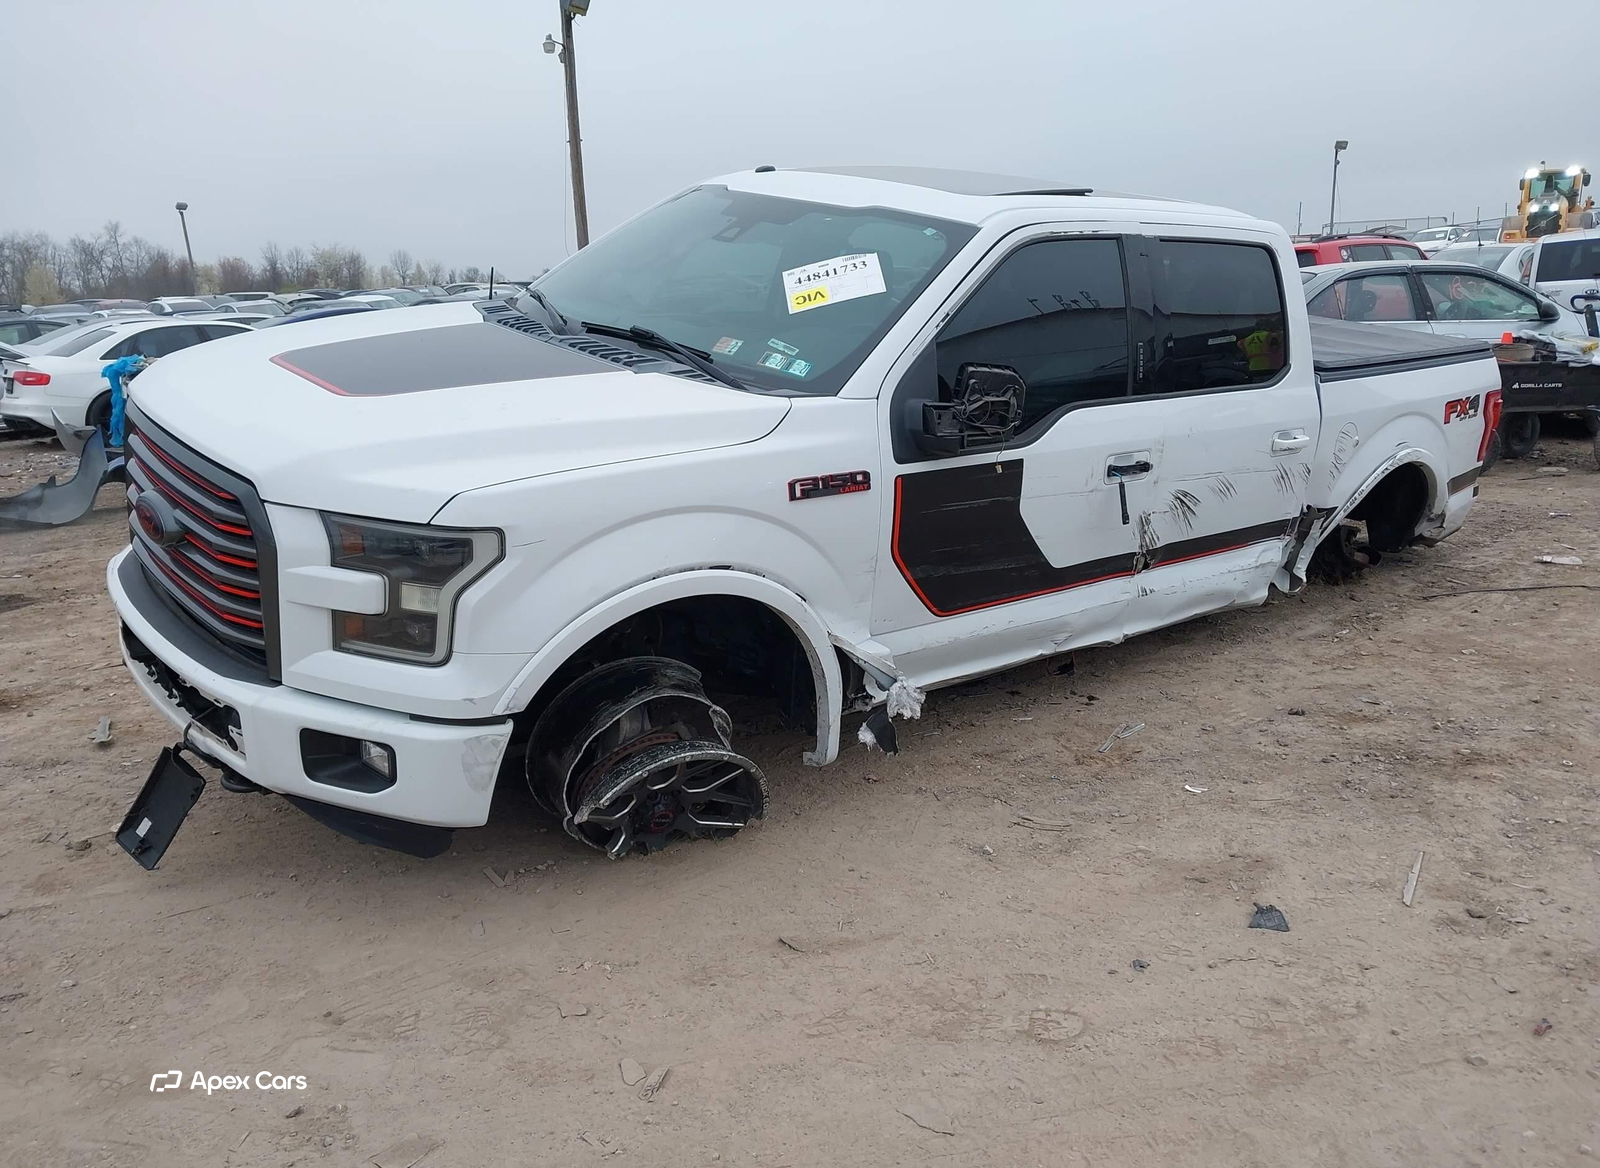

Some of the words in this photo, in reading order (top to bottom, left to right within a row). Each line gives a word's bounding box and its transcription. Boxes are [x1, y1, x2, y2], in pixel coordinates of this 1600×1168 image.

[794, 260, 868, 285] 44841733
[795, 291, 825, 305] VIC
[1444, 394, 1480, 425] FX4
[840, 484, 869, 494] LARIAT
